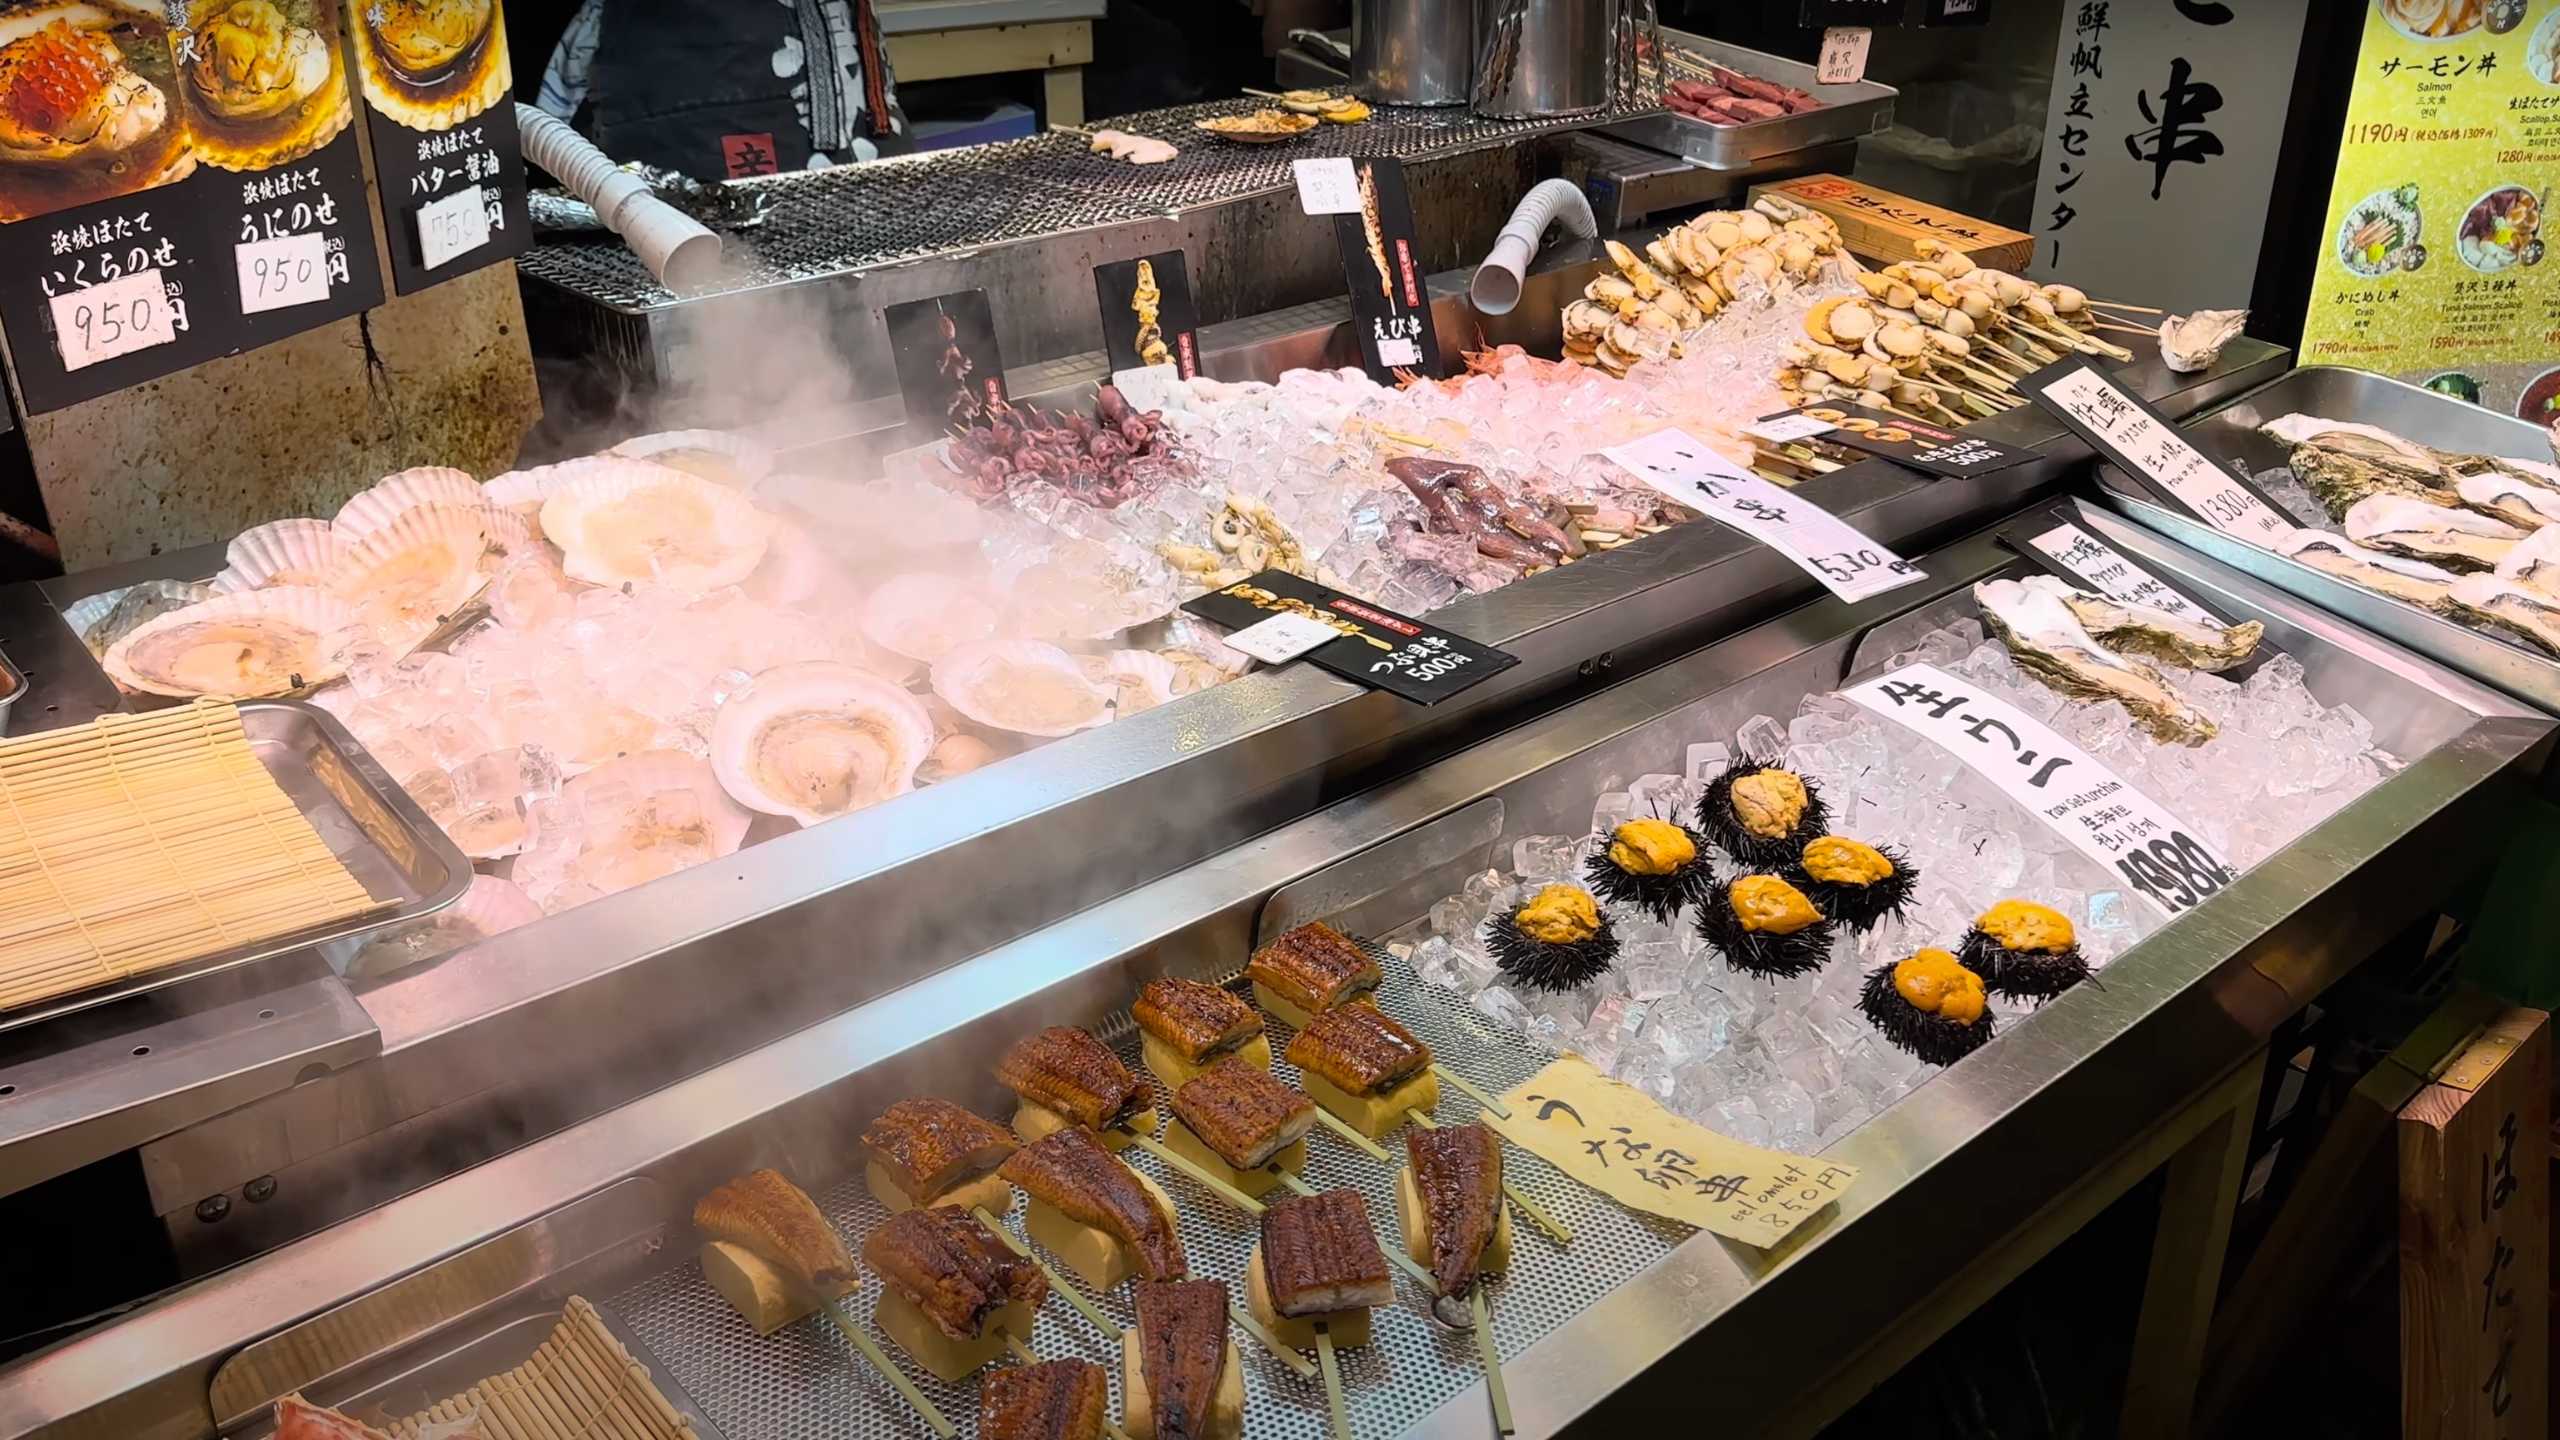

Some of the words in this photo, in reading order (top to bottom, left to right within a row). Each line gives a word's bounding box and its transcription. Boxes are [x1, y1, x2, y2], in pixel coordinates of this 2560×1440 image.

[2380, 52, 2497, 79] サーモン丼
[2125, 0, 2235, 200] 串
[2417, 82, 2452, 92] Salmon
[417, 127, 484, 161] 浜焼ほたて
[2047, 2, 2111, 269] 鮮帆立センター
[2349, 123, 2409, 144] 1190円
[243, 167, 321, 205] 浜焼ほたて
[410, 149, 500, 196] バター醤油
[51, 211, 153, 256] 浜焼ほたて
[241, 192, 338, 243] うにのせ
[41, 237, 178, 297] いくらのせ
[254, 258, 312, 298] 950
[327, 252, 350, 285] 円
[2336, 289, 2400, 304] かにめし丼
[2355, 308, 2375, 316] Crab
[75, 299, 151, 351] 950
[1374, 315, 1422, 340] えび串
[2069, 387, 2136, 432] 牡蠣
[2117, 419, 2150, 446] oyster
[2089, 562, 2128, 585] oyster
[1369, 636, 1450, 675] つぶ貝串
[1404, 652, 1473, 681] 500円
[1877, 680, 2073, 788] 生ウニ
[2115, 831, 2231, 913] 1980
[1757, 1164, 1808, 1204] omelet
